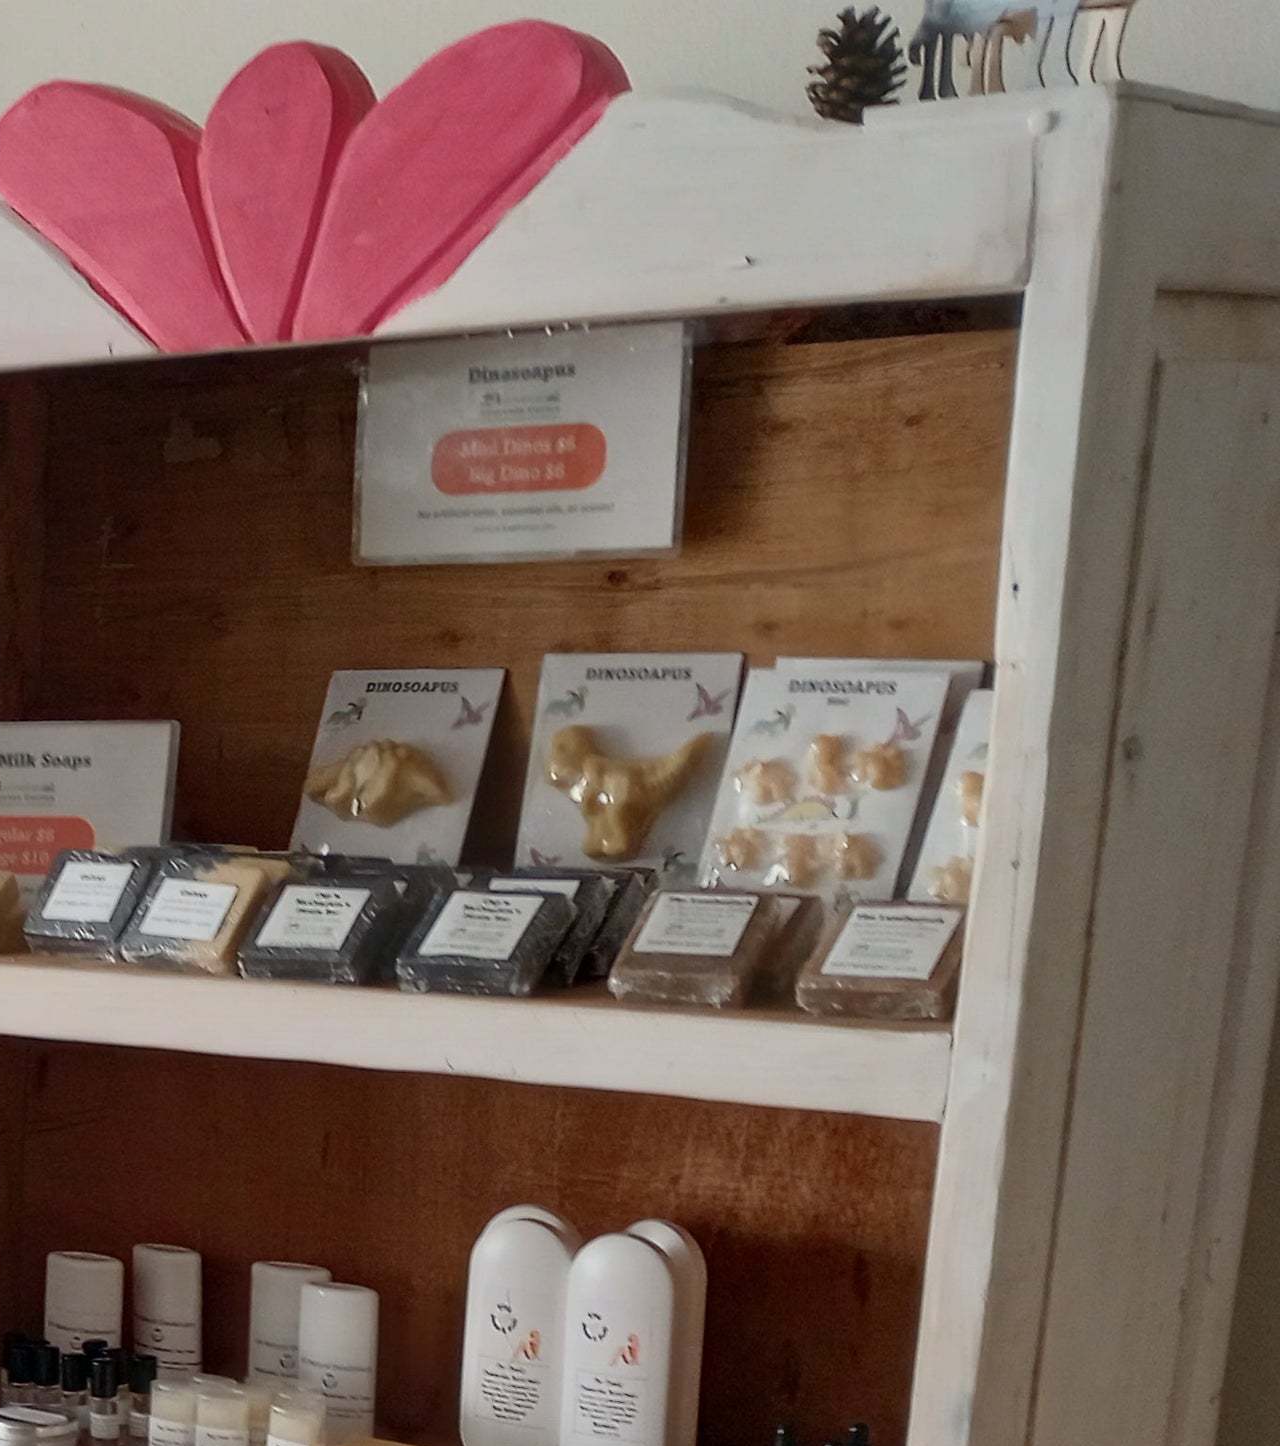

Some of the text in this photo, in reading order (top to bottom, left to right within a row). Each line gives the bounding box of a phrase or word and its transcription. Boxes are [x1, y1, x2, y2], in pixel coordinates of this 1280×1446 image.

[585, 667, 693, 681] DINOSOAPUS
[366, 680, 459, 694] DINOSOAPUS
[788, 679, 897, 696] DINOSOAPUS
[41, 753, 92, 771] Soaps
